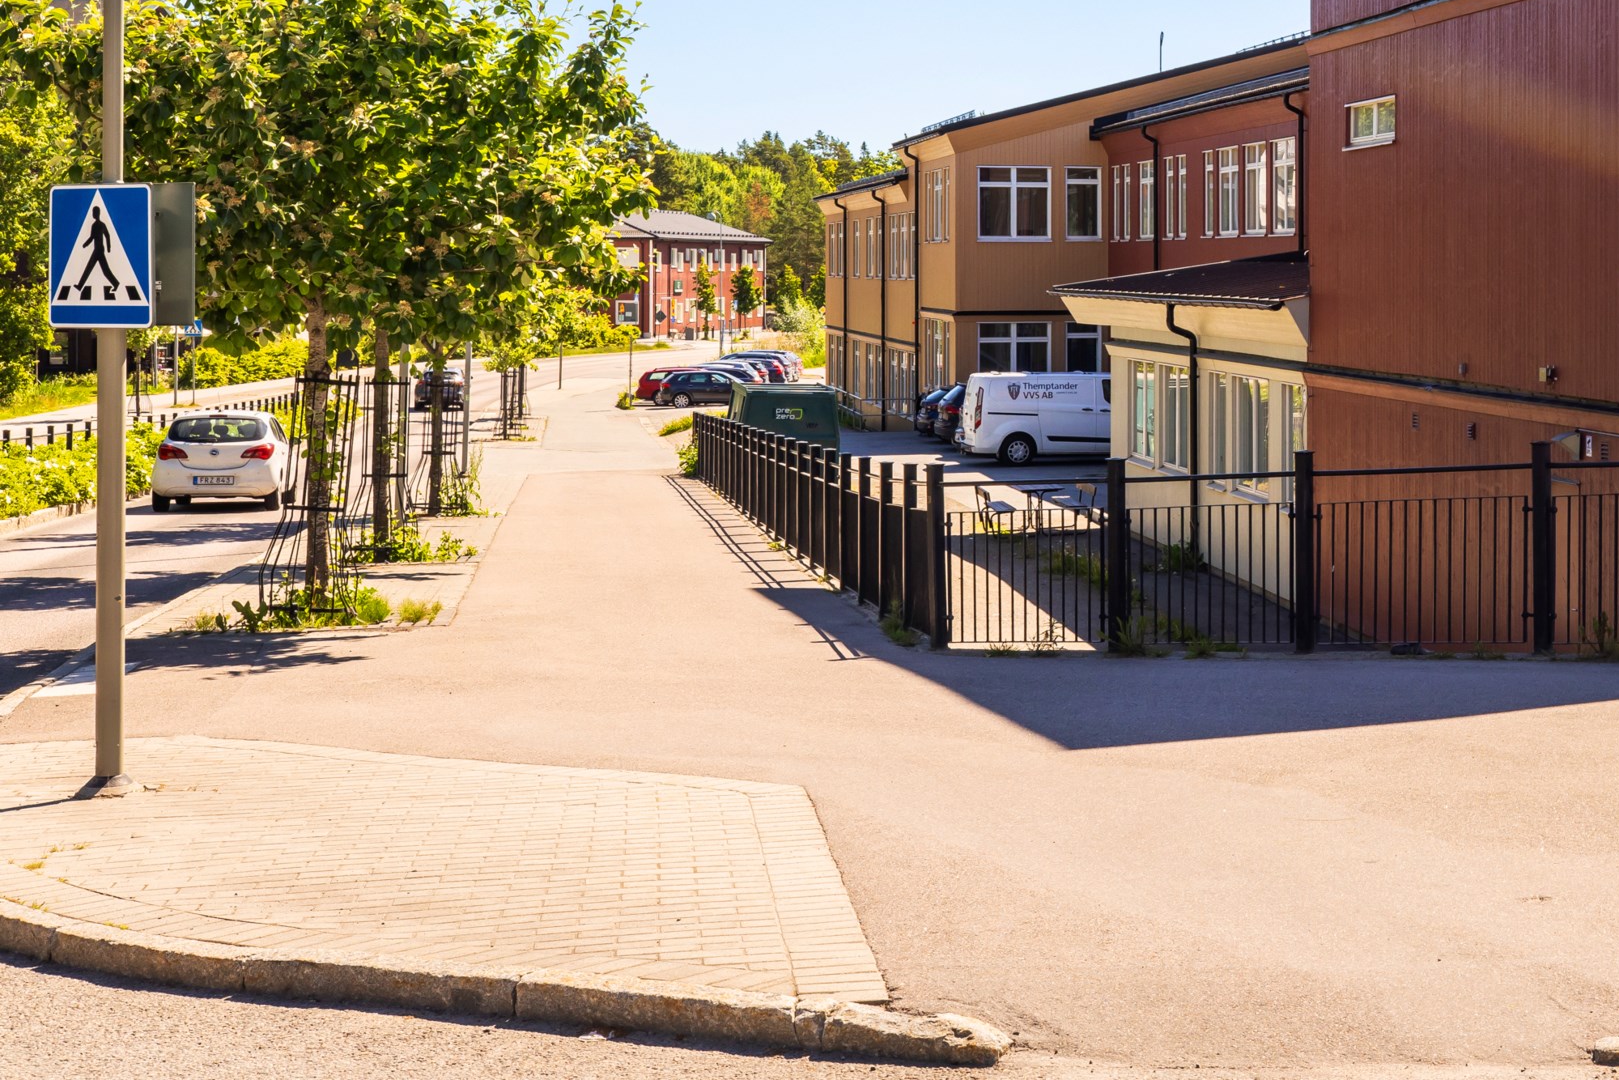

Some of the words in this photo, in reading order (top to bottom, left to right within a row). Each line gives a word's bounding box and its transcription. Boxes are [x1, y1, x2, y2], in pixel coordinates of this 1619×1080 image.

[1023, 382, 1078, 391] Themptander
[1023, 391, 1040, 399] VVS
[1041, 391, 1054, 399] AB
